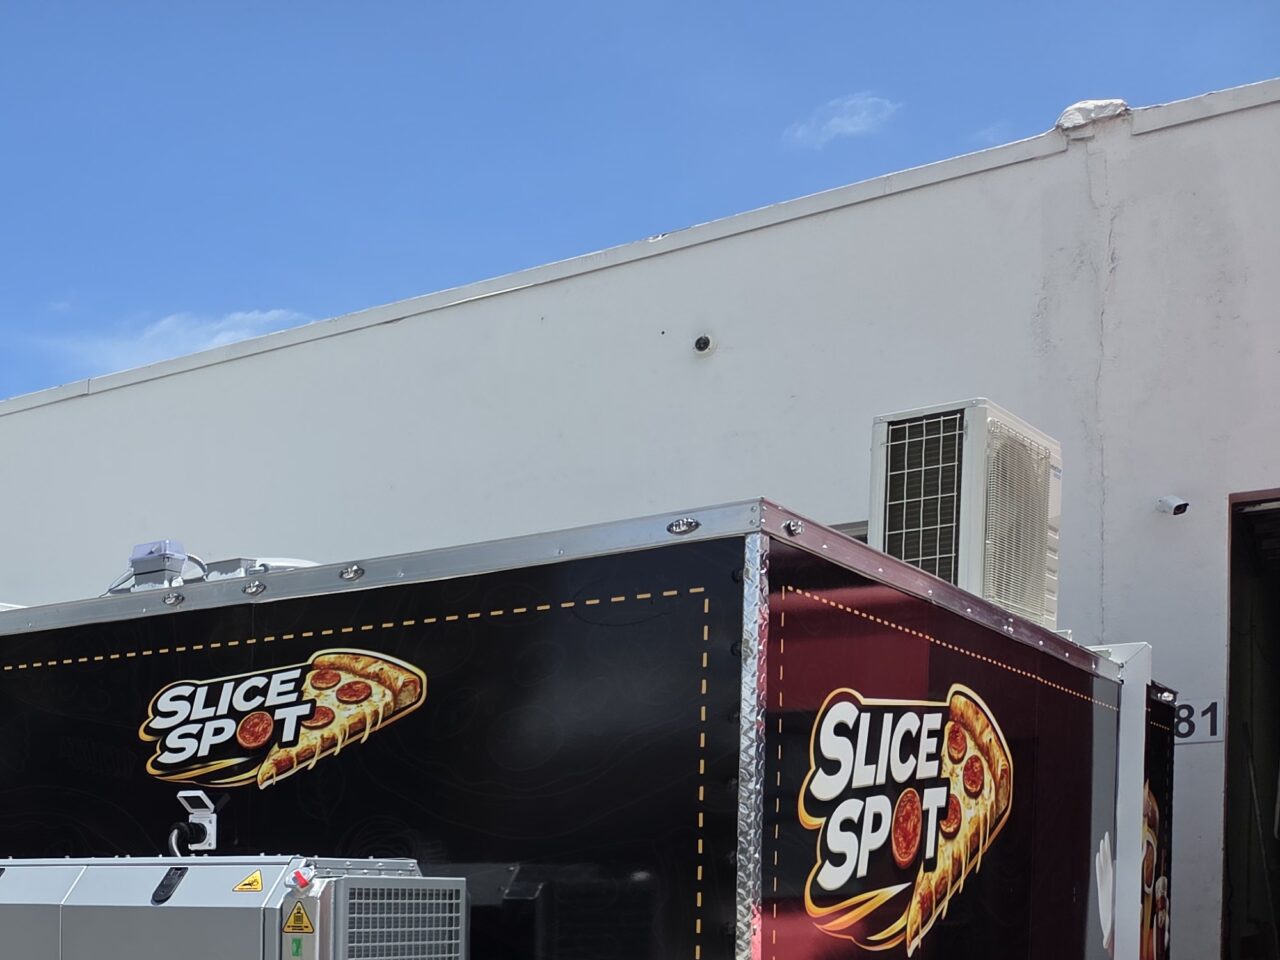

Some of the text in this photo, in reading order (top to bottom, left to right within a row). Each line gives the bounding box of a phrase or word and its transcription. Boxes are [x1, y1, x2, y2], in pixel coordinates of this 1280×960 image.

[148, 668, 302, 730] SLICE
[156, 702, 312, 764] SPOT
[809, 701, 943, 801] SLICE
[816, 786, 948, 891] SPOT
